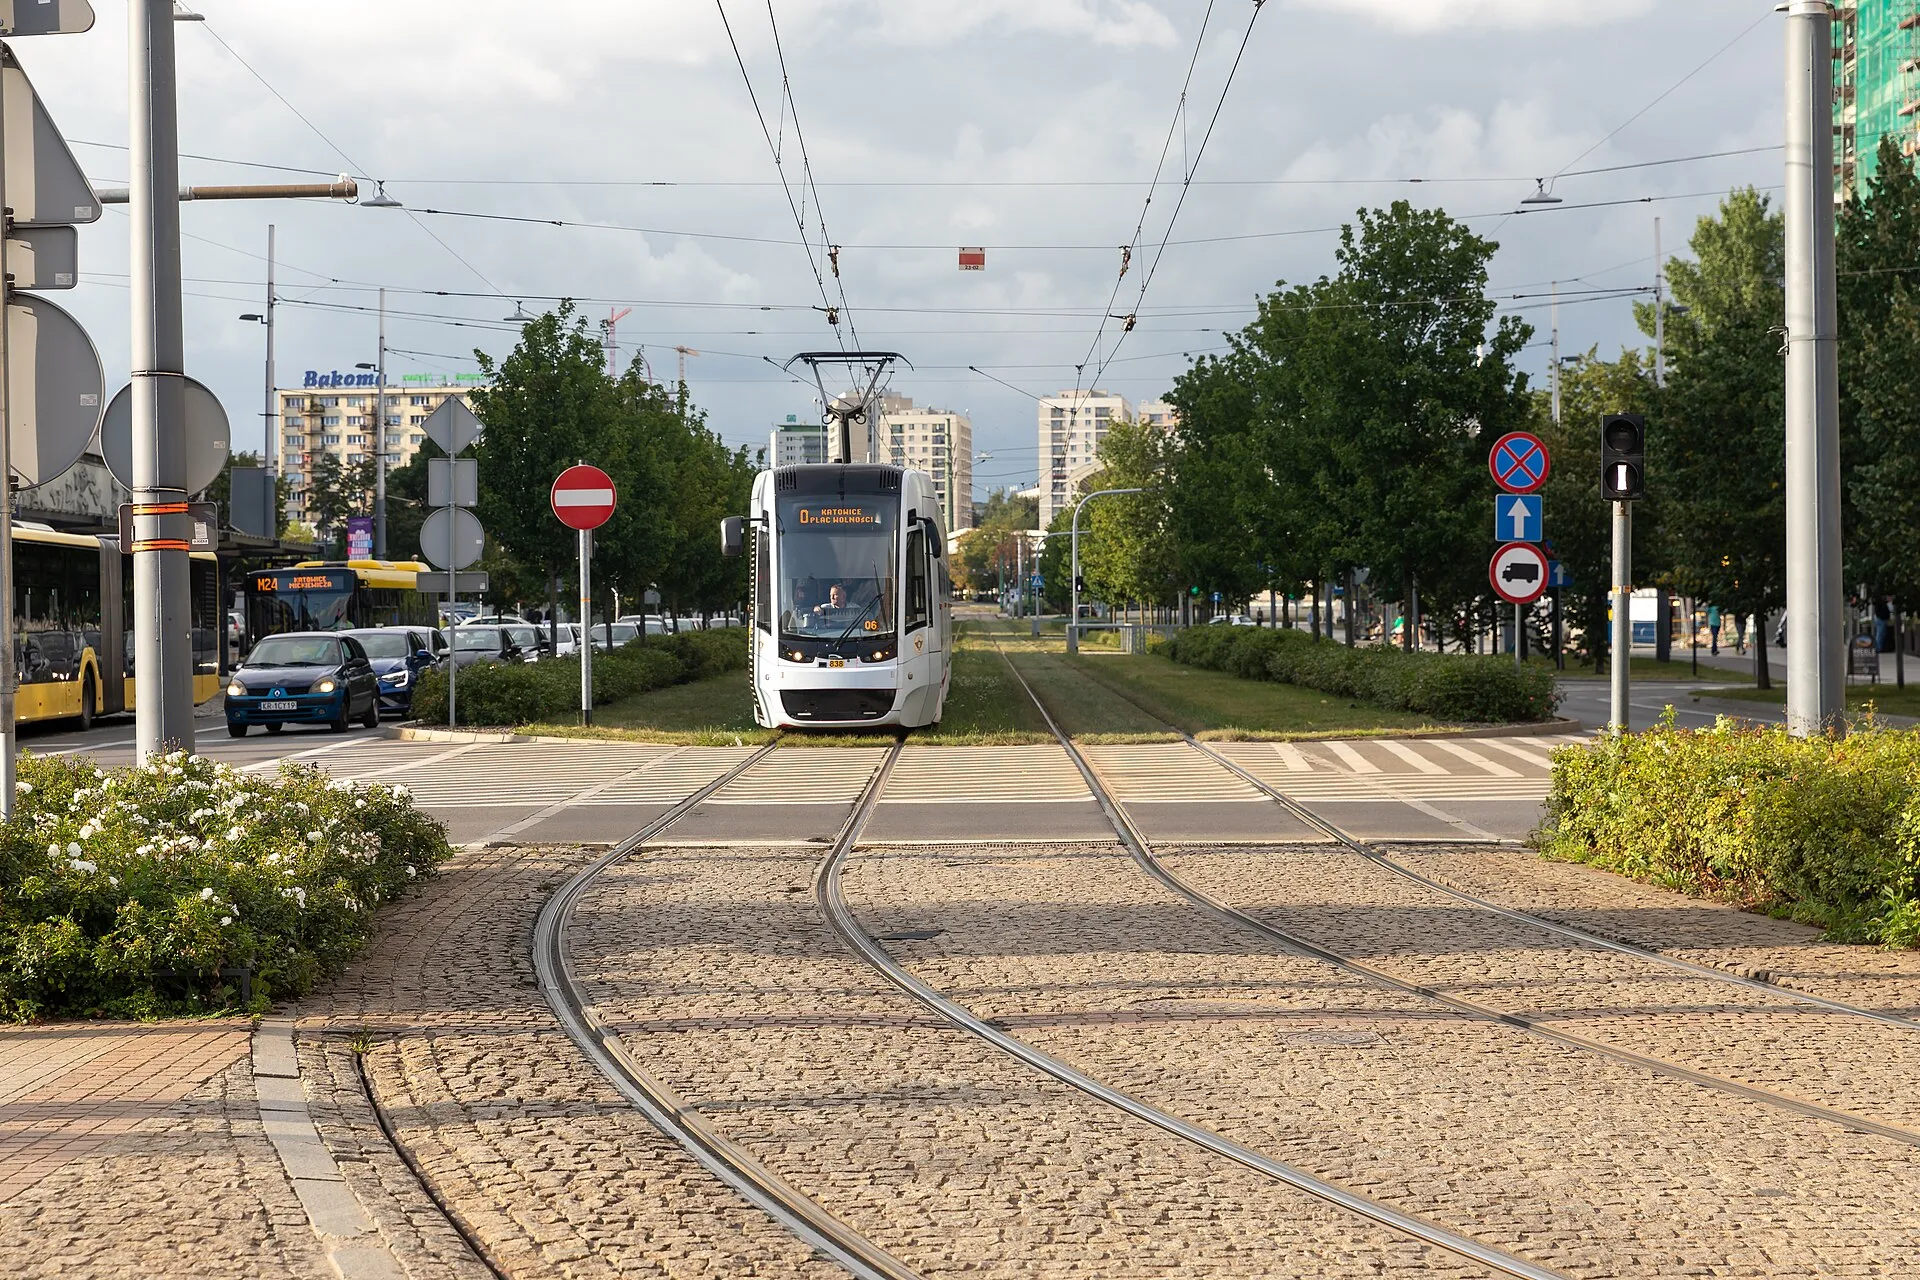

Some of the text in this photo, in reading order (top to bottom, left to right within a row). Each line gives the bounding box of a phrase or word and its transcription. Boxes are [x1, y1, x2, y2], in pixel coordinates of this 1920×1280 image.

[304, 371, 387, 387] Bakoma
[821, 508, 862, 516] KATOWICE
[809, 516, 873, 524] PLAC WOLNOŚCI
[257, 578, 278, 591] M24
[864, 620, 877, 630] 06
[829, 660, 844, 668] 838
